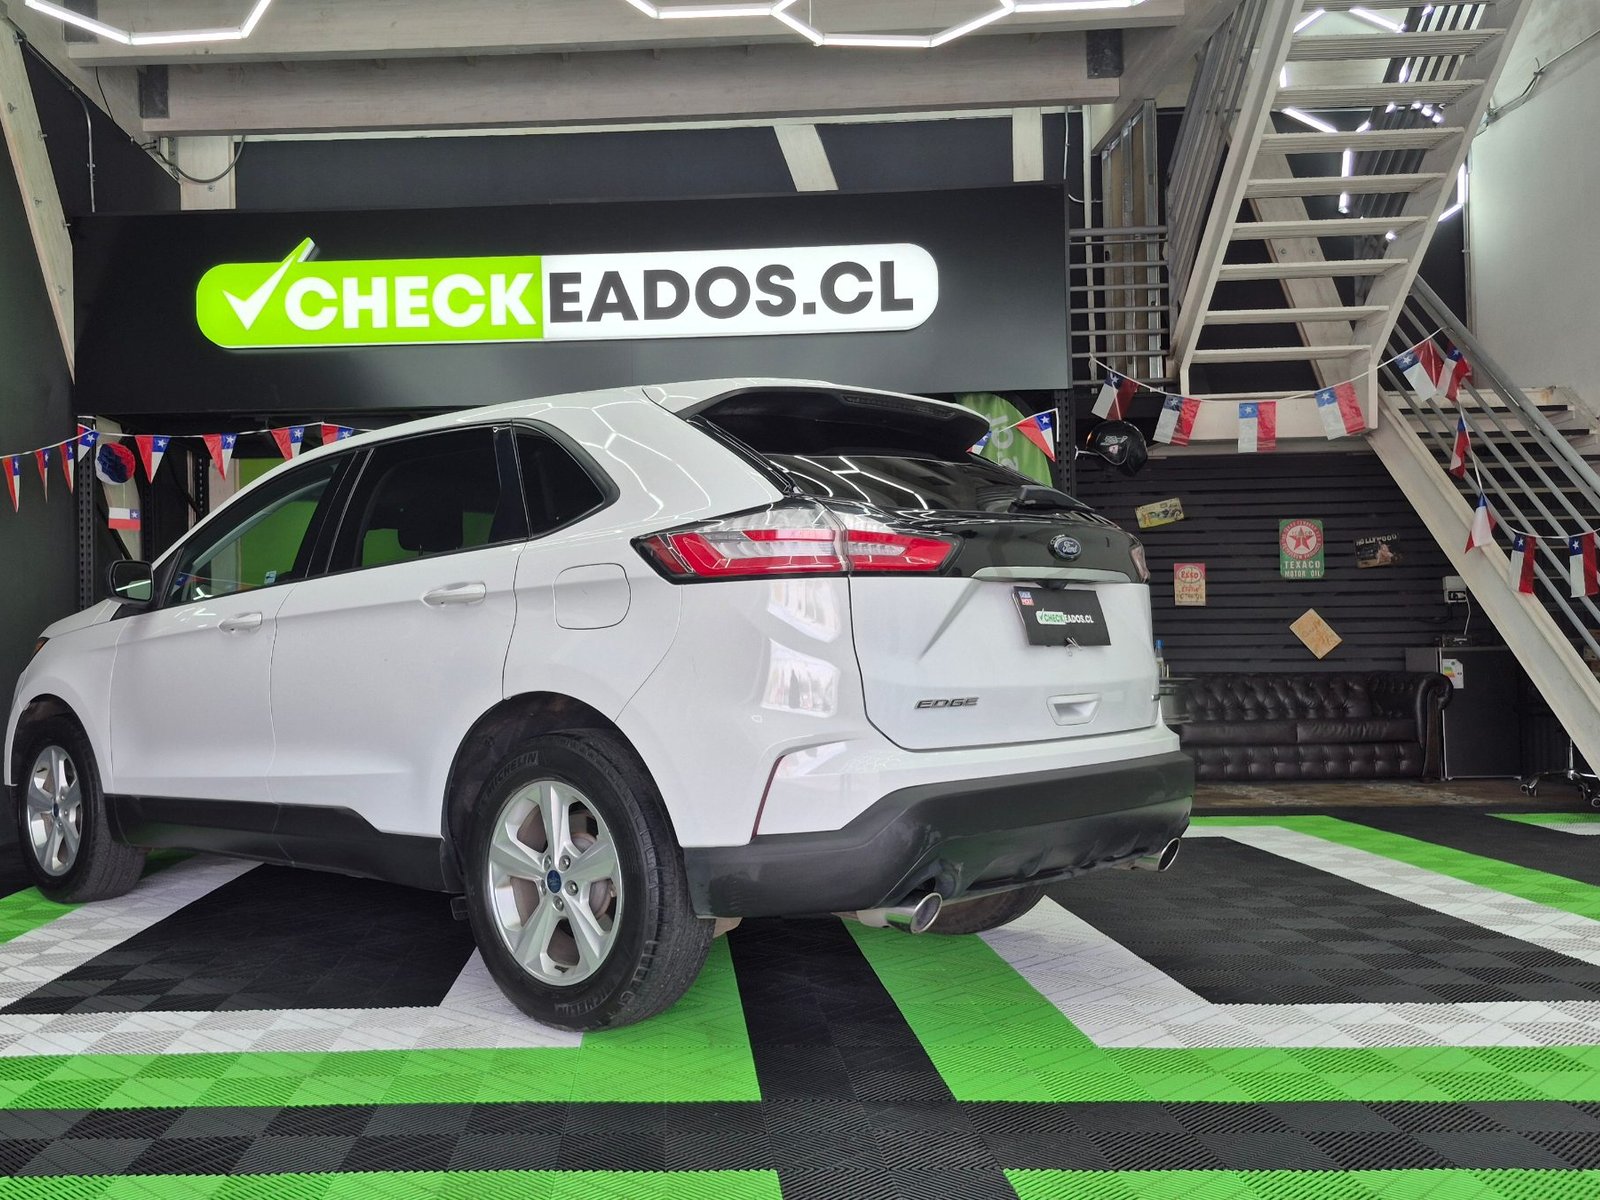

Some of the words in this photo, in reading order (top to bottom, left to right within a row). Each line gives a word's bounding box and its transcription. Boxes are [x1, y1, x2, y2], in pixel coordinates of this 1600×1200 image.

[284, 259, 914, 332] CHECKEADOS.CL
[1284, 560, 1321, 570] TEXACO
[1284, 569, 1306, 578] MOTOR
[1310, 569, 1321, 578] OIL
[914, 696, 980, 710] EDGE
[481, 750, 539, 803] MICHELIN
